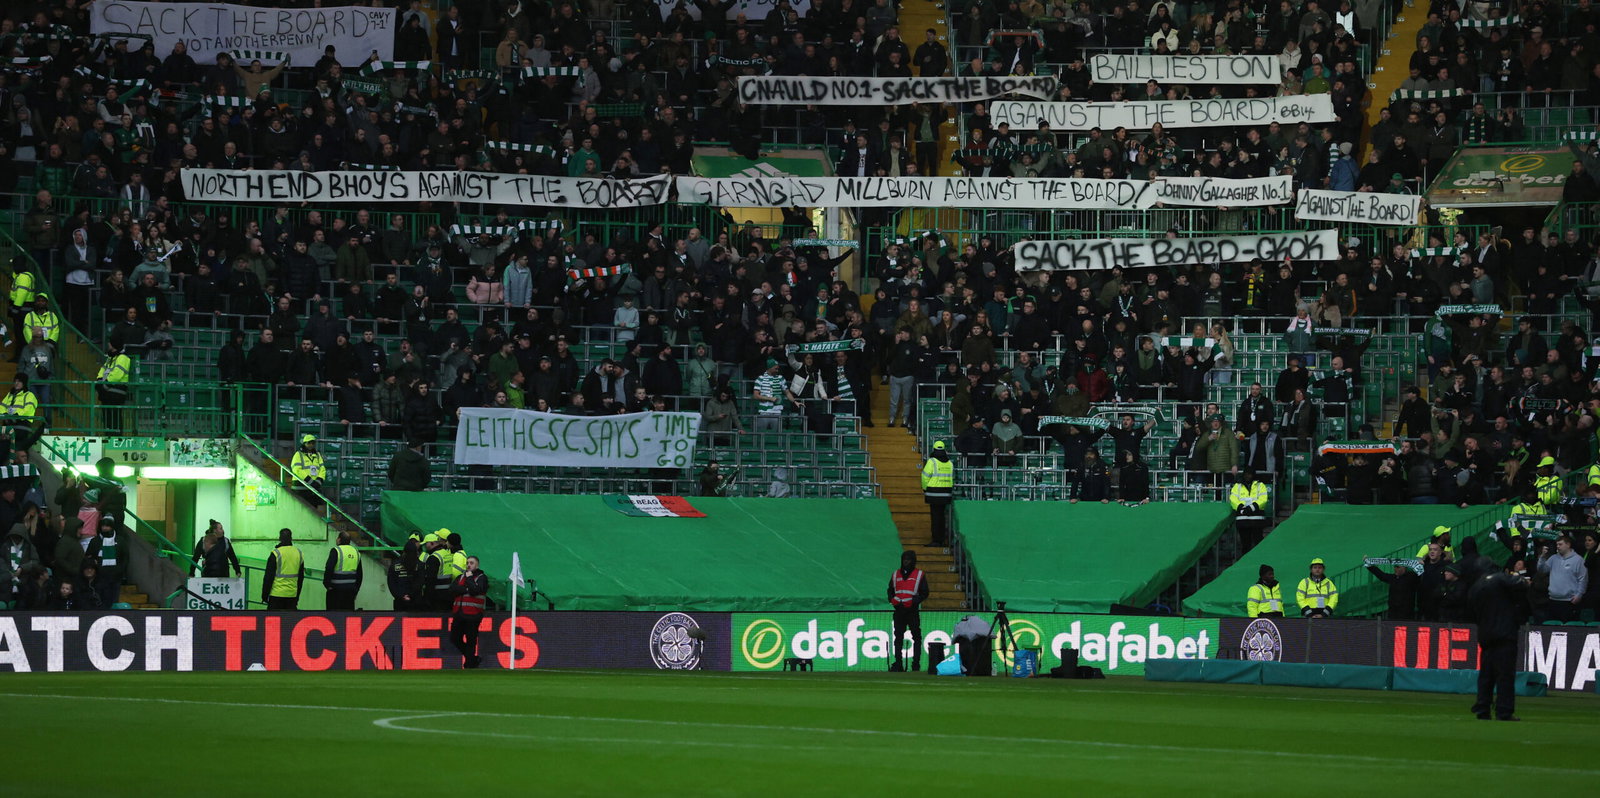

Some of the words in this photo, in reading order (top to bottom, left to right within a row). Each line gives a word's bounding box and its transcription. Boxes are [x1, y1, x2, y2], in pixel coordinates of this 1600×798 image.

[102, 4, 200, 36] SACK
[208, 7, 268, 36] THE
[276, 10, 369, 38] BOARD
[718, 57, 750, 65] CELTIC
[1096, 56, 1272, 80] BAILLIESTON
[741, 79, 828, 101] CNAULD
[937, 78, 983, 99] THE
[986, 76, 1056, 97] BOARD
[995, 103, 1115, 127] AGAINST
[1124, 103, 1176, 125] THE
[1190, 98, 1277, 122] BOARD!
[191, 173, 263, 198] NORTH
[268, 172, 322, 199] END
[330, 172, 409, 199] BHOYS
[505, 177, 568, 203] THE
[576, 179, 668, 208] BOARD
[692, 178, 825, 205] GARNGAD
[836, 178, 933, 202] MILLBURN
[944, 178, 1023, 201] AGAINST
[1028, 180, 1066, 201] THE
[1071, 180, 1150, 209] BOARD!
[1453, 174, 1567, 188] dafbet
[1020, 242, 1090, 270] SACK
[1090, 241, 1145, 269] THE
[652, 414, 697, 439] TIME
[122, 452, 148, 461] 109
[659, 439, 688, 452] TO
[202, 583, 230, 594] Exit
[227, 598, 244, 610] 14
[1394, 626, 1482, 671] UE
